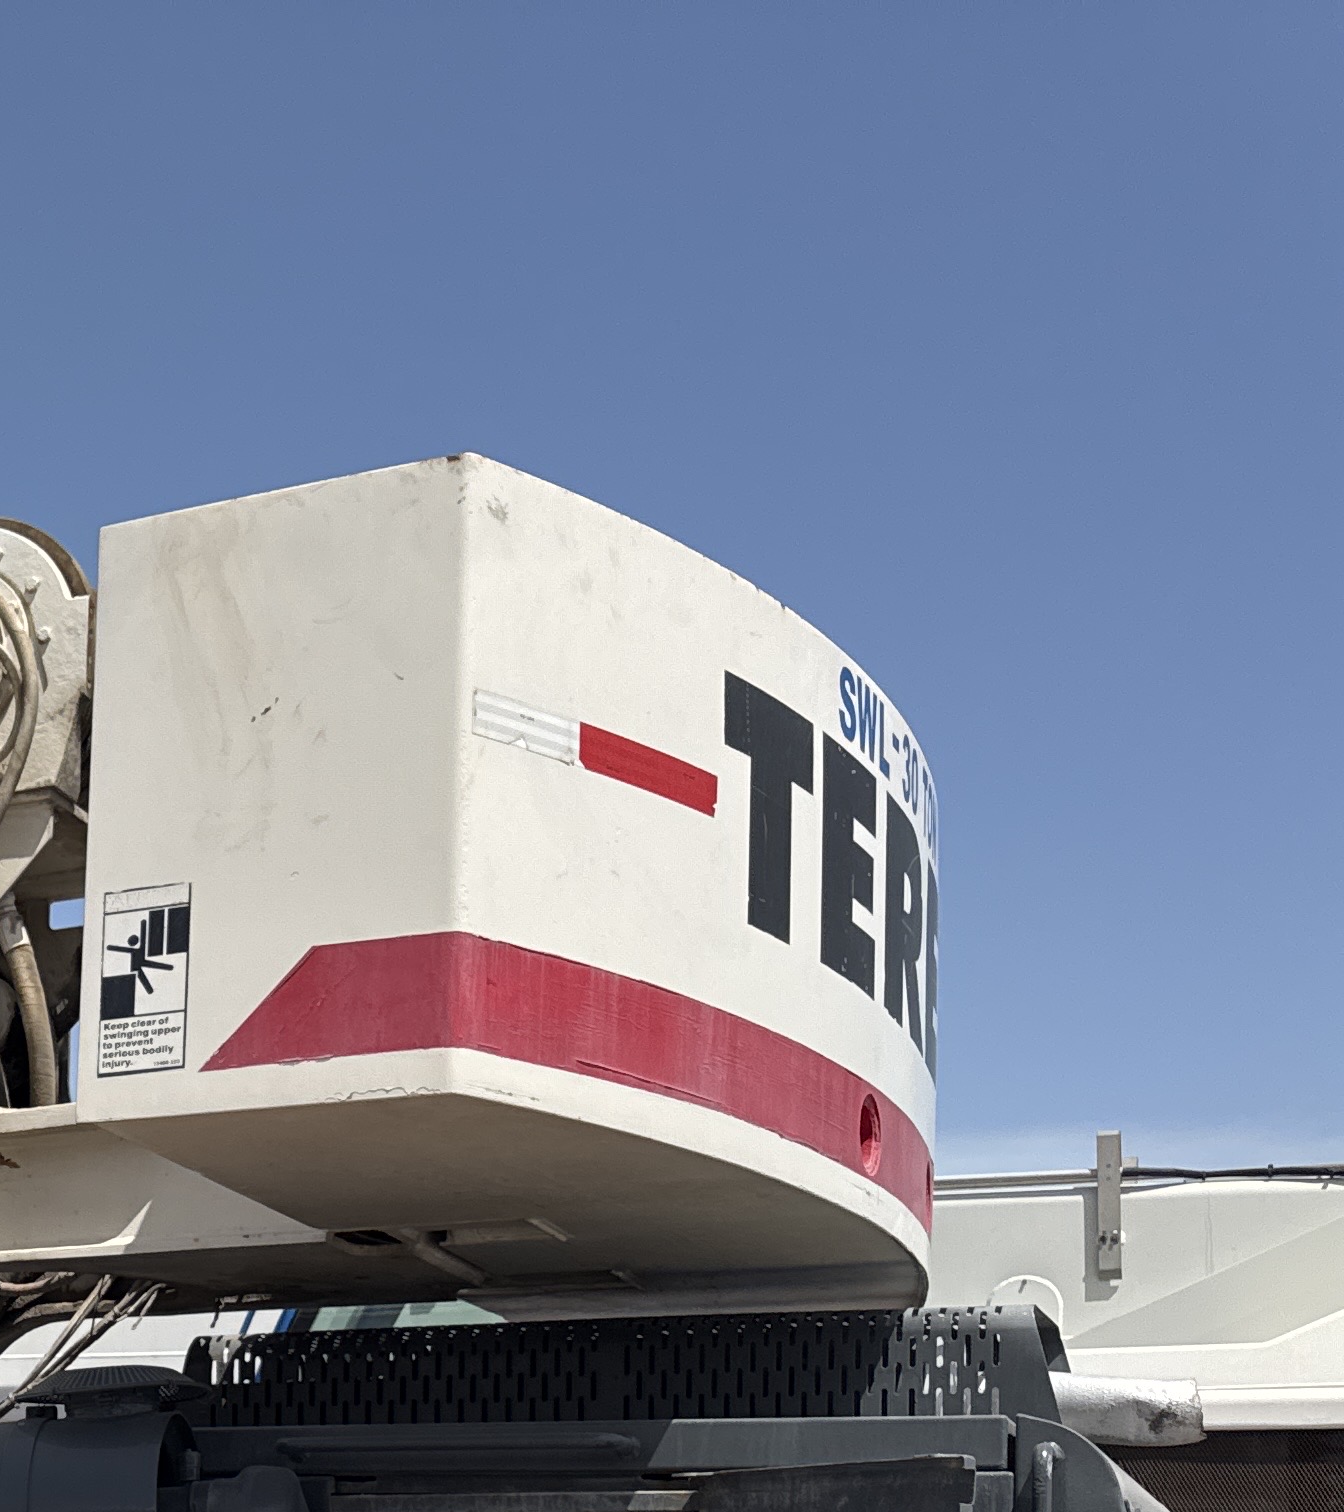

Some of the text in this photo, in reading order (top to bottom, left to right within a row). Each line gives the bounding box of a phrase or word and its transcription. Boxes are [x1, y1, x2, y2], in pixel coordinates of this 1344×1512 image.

[103, 1016, 169, 1031] Keep clear of
[103, 1026, 181, 1040] swinging upper
[102, 1038, 153, 1050] to prevent
[102, 1045, 174, 1059] serious bodily
[102, 1059, 133, 1069] injury.
